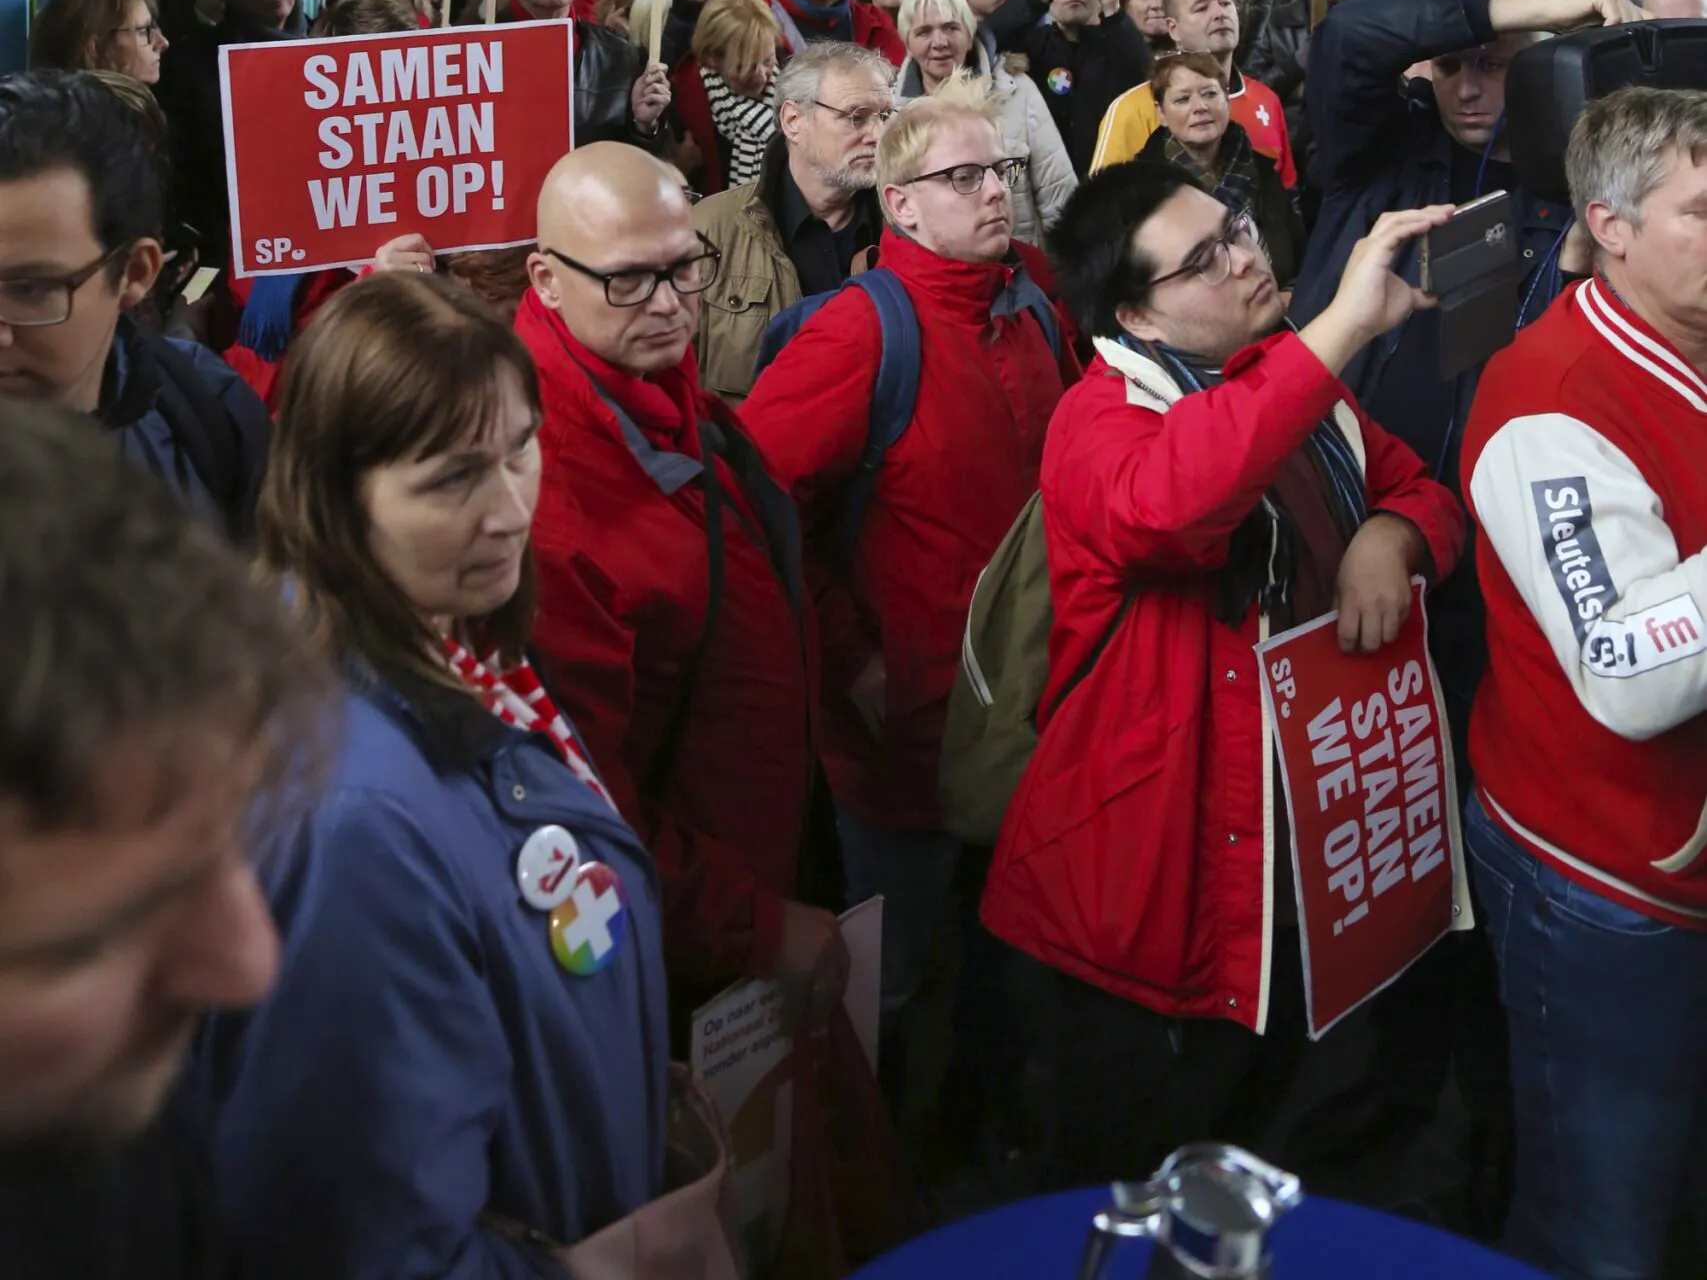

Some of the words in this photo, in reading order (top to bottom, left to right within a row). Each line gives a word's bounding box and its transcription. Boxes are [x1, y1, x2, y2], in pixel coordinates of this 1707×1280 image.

[302, 40, 504, 110] SAMEN
[317, 101, 496, 170] STAAN
[306, 171, 398, 231] WE
[415, 160, 505, 218] OP!
[1645, 616, 1699, 653] fm
[1306, 696, 1357, 813] WE
[1387, 659, 1445, 883] SAMEN
[1350, 691, 1406, 898] STAAN
[1323, 819, 1370, 937] OP!
[703, 1017, 724, 1036] Op
[727, 1000, 756, 1024] naar
